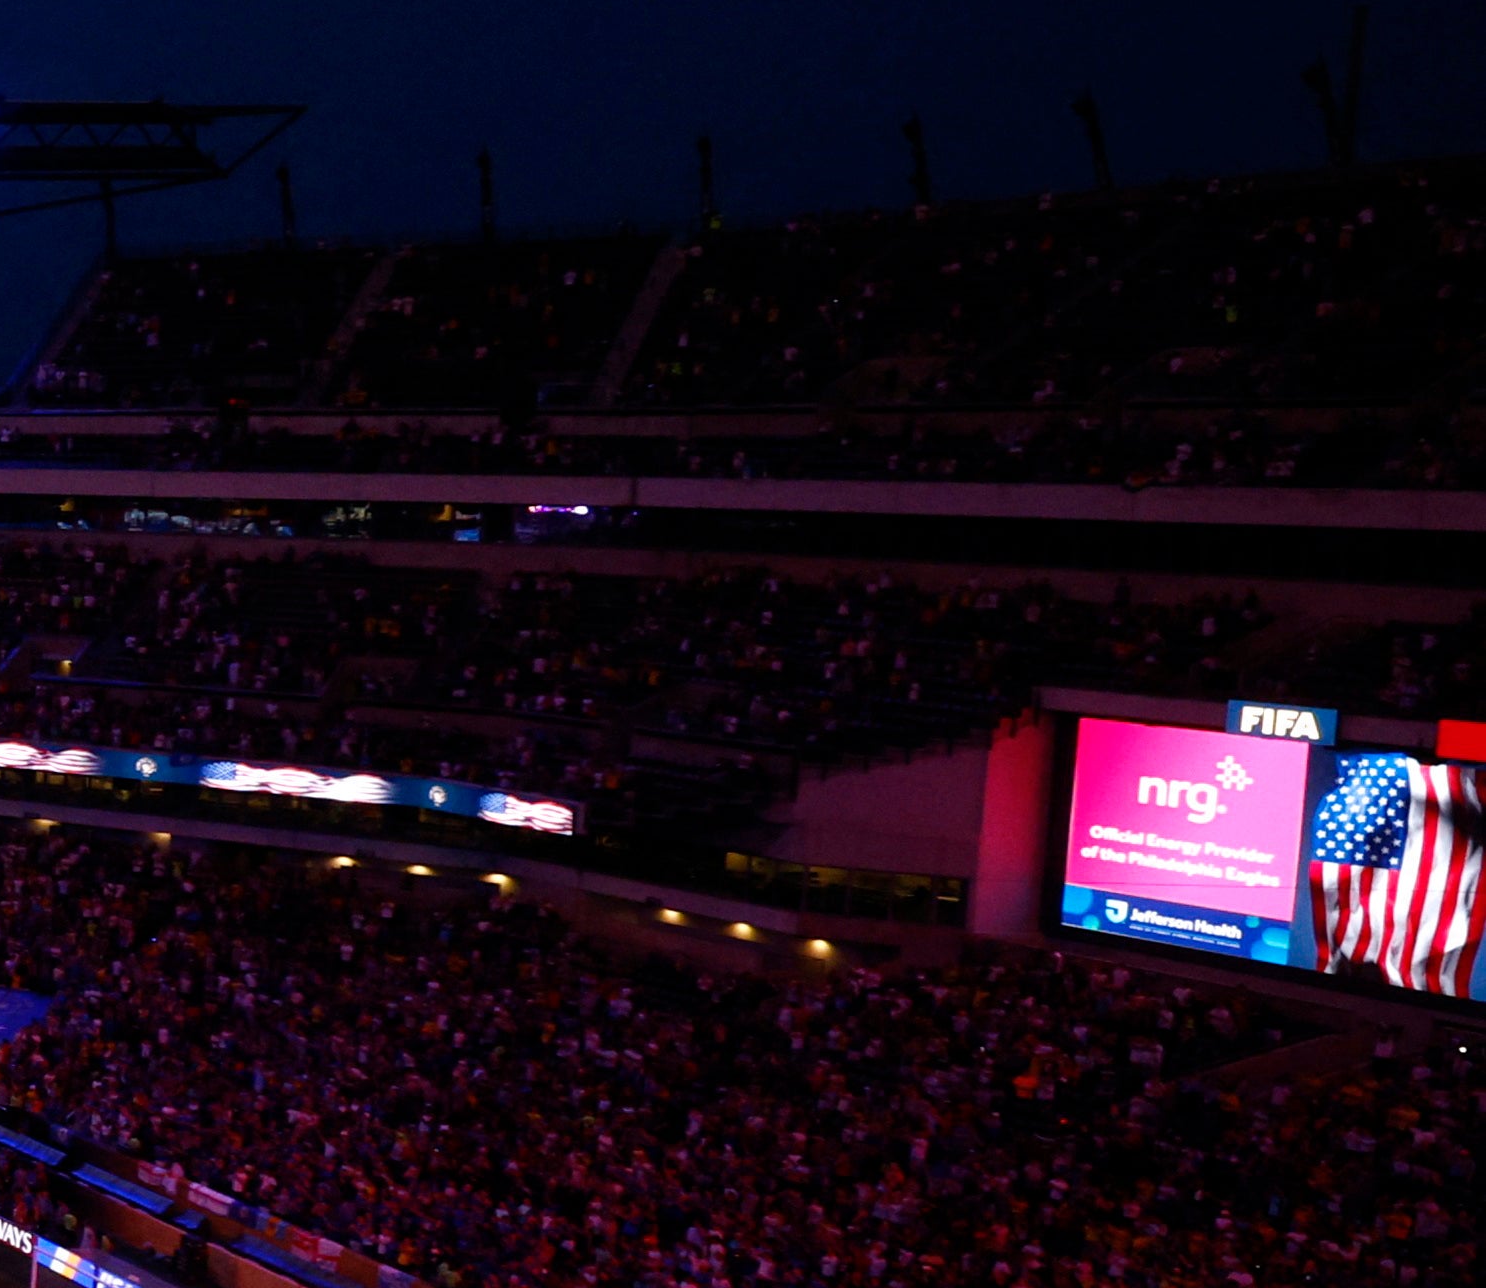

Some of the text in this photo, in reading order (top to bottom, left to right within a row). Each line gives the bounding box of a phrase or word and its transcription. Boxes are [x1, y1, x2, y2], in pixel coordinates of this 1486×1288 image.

[1240, 705, 1321, 741] FIFA
[1089, 825, 1275, 864] Official Energy Provider
[1080, 846, 1280, 887] of the Philadelphia Eagles
[1130, 908, 1193, 931] Jefferson
[1194, 919, 1242, 940] Health
